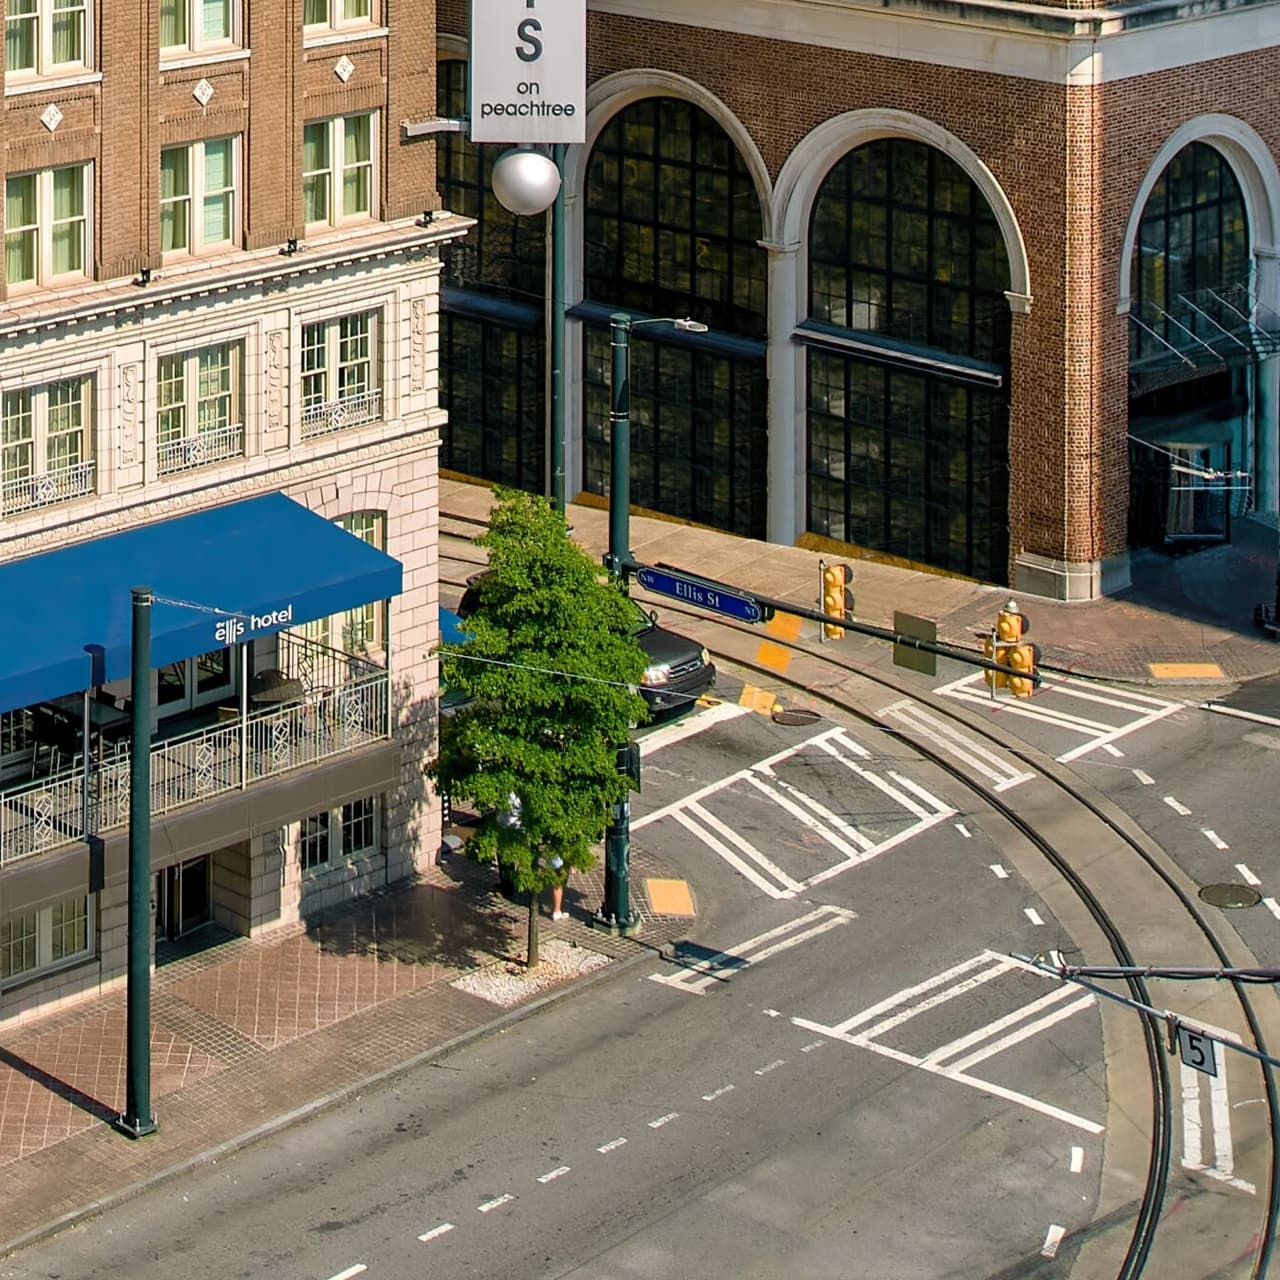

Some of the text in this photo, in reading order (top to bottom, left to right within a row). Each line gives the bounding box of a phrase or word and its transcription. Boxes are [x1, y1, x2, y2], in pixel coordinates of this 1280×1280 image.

[516, 81, 540, 95] on
[481, 99, 576, 119] peachtree
[675, 582, 704, 602] Ellis
[707, 592, 721, 608] St
[215, 603, 292, 644] ellis hotel
[1188, 1034, 1205, 1067] 5
